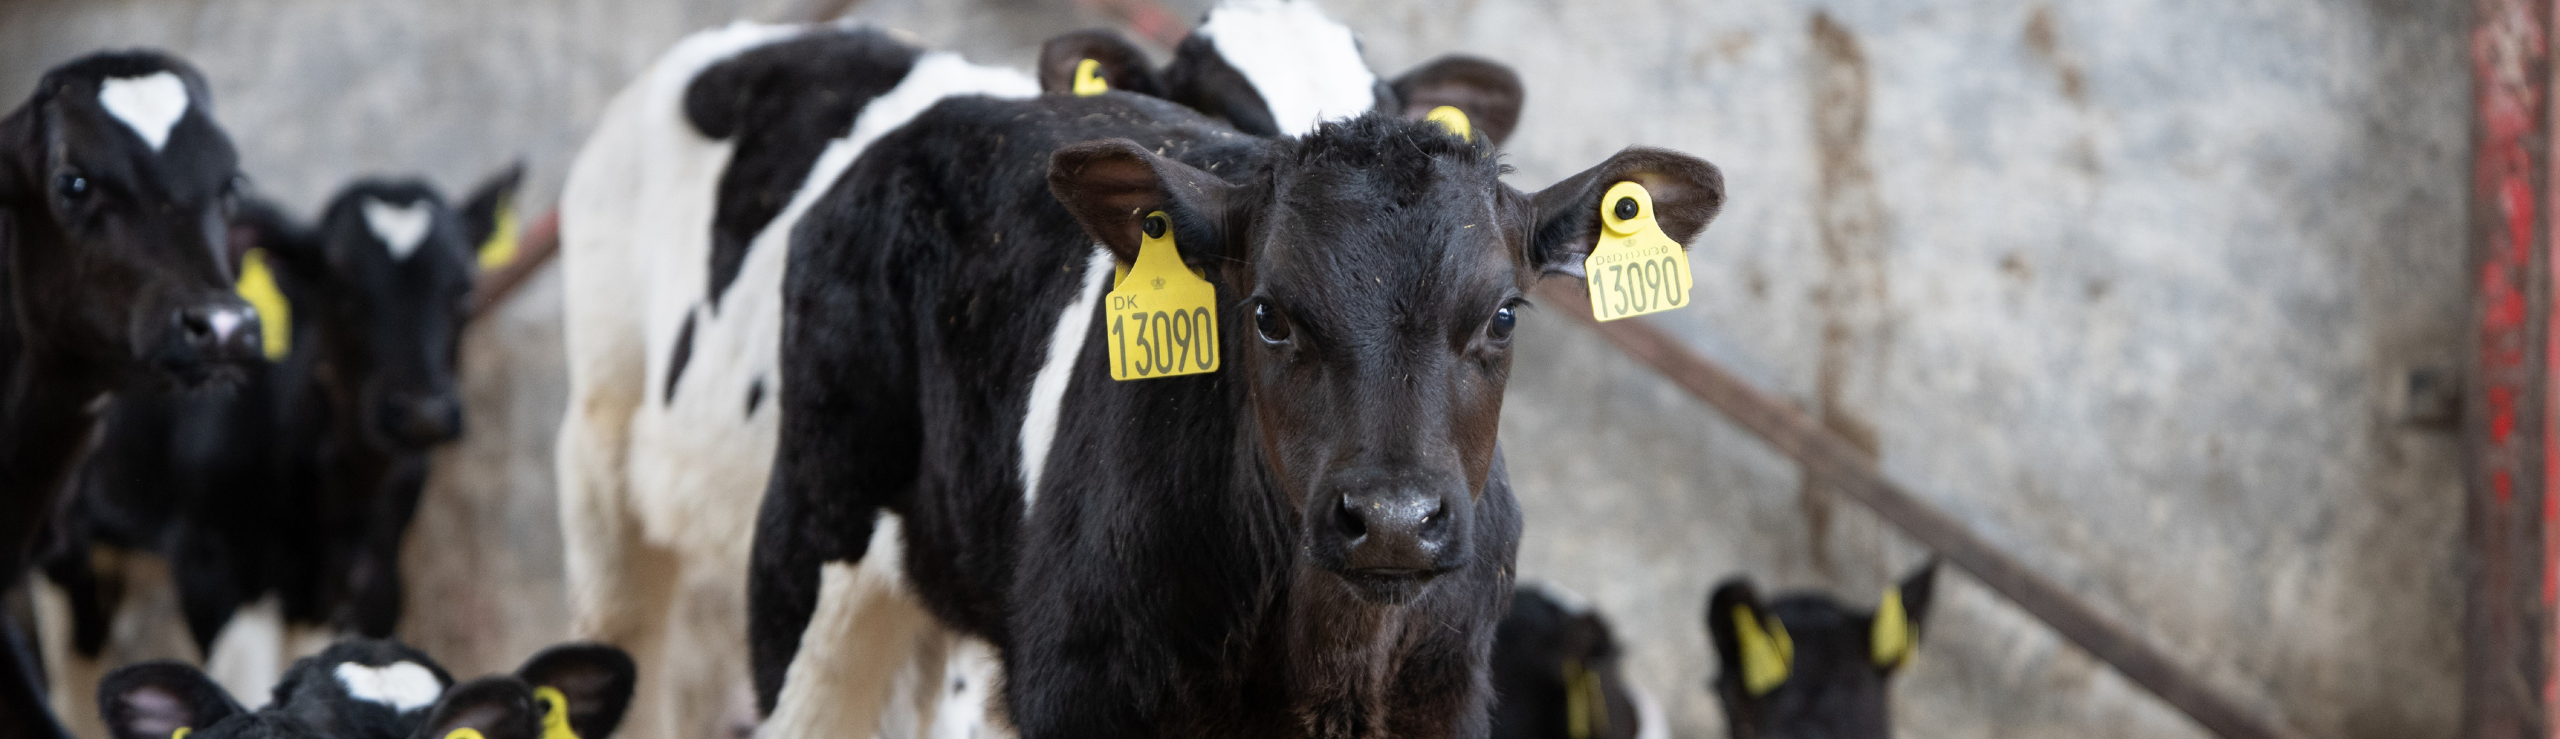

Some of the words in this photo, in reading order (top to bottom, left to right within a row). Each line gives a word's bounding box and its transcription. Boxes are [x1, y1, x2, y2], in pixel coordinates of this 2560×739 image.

[1113, 294, 1139, 311] DK
[1593, 256, 1682, 318] 13090
[1112, 306, 1214, 378] 13090
